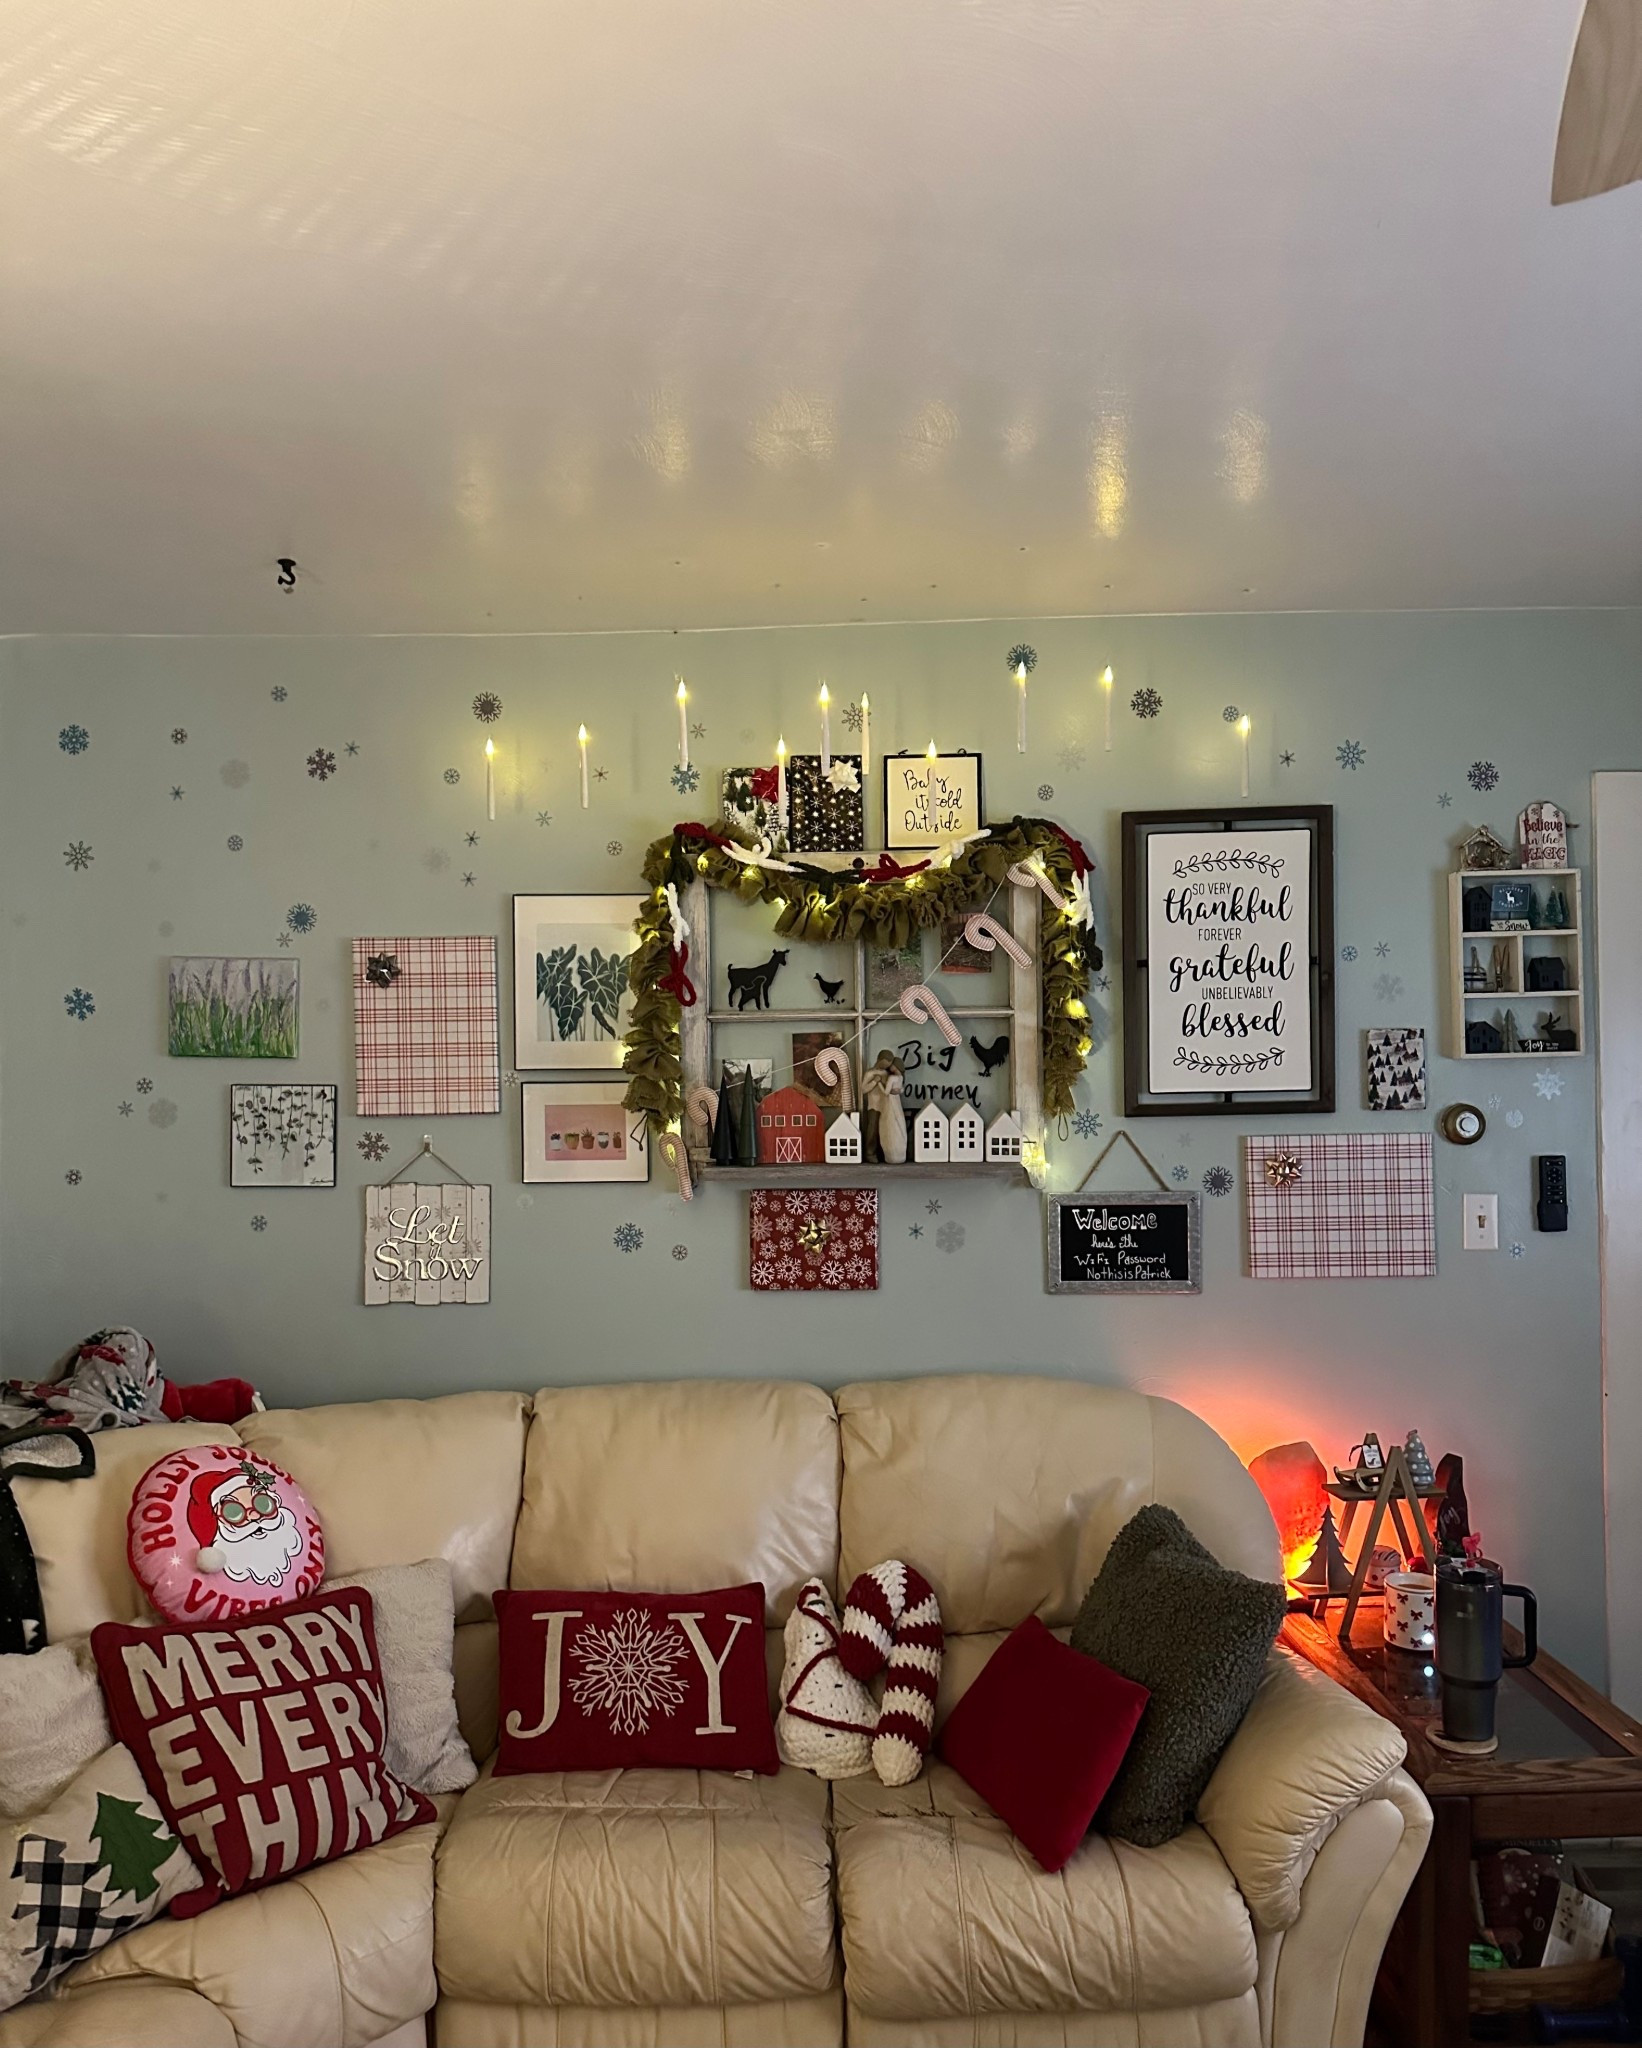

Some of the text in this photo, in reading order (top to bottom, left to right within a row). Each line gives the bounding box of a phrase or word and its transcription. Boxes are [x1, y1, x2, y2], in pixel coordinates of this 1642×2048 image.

[904, 810, 962, 833] Outside
[1524, 818, 1563, 833] Believe
[1542, 832, 1561, 845] the
[1192, 882, 1231, 895] SO VERY
[1163, 885, 1293, 926] thankful
[1198, 928, 1242, 941] FOREVER
[1504, 920, 1529, 931] Snow
[1169, 941, 1294, 993] grateful
[1201, 986, 1273, 1000] UNBELIEVABLY
[1181, 1000, 1286, 1038] blessed
[898, 1039, 957, 1072] Big
[1524, 1039, 1544, 1052] Joy
[901, 1079, 982, 1109] ourney
[386, 1205, 465, 1246] Let
[1091, 1233, 1139, 1249] here's the
[373, 1242, 484, 1282] Snow
[1117, 1250, 1166, 1266] Password
[140, 1455, 200, 1555] HOLLY
[295, 1516, 325, 1600] ONLY
[121, 1603, 373, 1721] MERRY
[148, 1678, 385, 1812] EVERY
